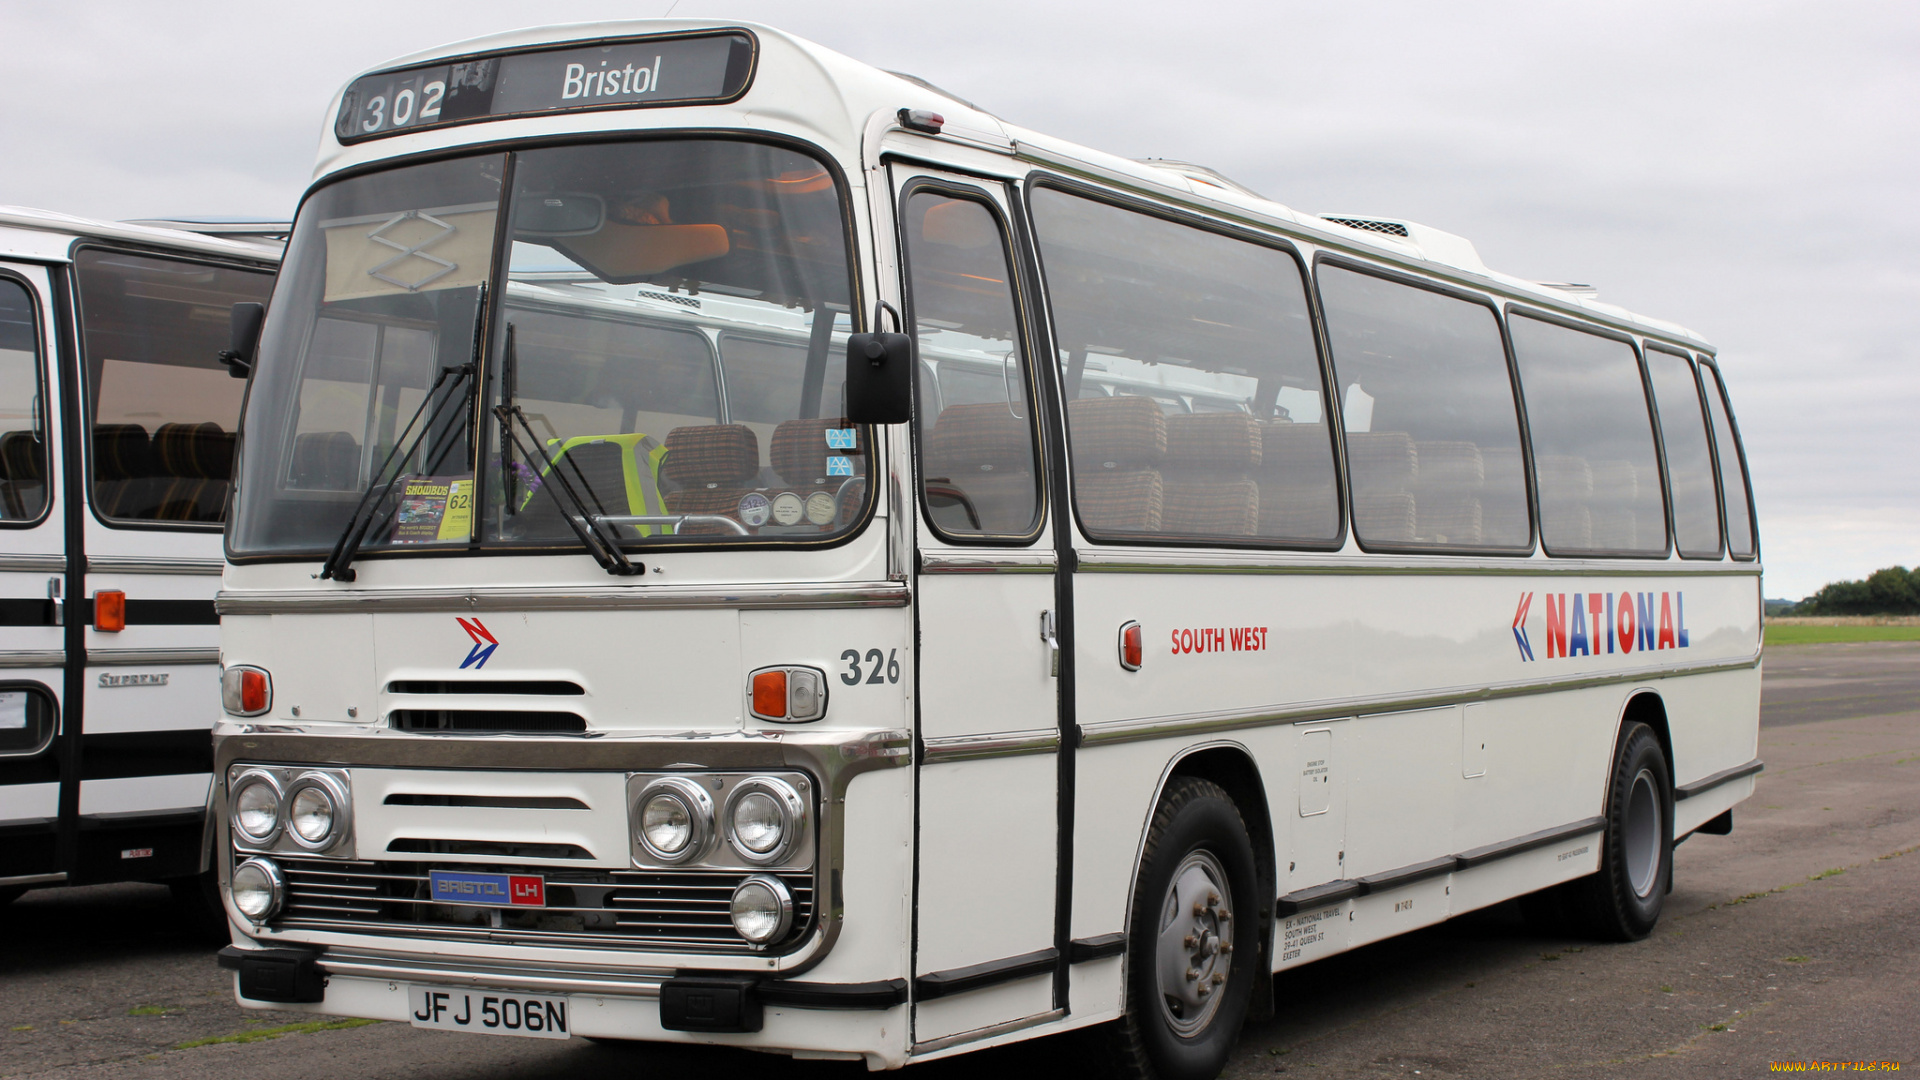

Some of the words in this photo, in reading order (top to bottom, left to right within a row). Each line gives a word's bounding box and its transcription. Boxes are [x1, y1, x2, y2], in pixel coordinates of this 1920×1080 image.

[561, 54, 661, 100] Bristol
[362, 80, 446, 133] 302
[1546, 591, 1690, 659] NATIONAL
[1171, 628, 1225, 656] SOUTH
[1229, 627, 1268, 652] WEST
[840, 648, 900, 686] 326
[438, 879, 505, 896] BRISTOL
[515, 883, 538, 898] LH
[1284, 927, 1303, 941] SOUTH
[1285, 920, 1293, 930] EX
[1297, 912, 1323, 927] NATIONAL
[1282, 949, 1302, 962] EXETER
[1299, 935, 1317, 947] QUEEN
[482, 996, 567, 1032] 506N
